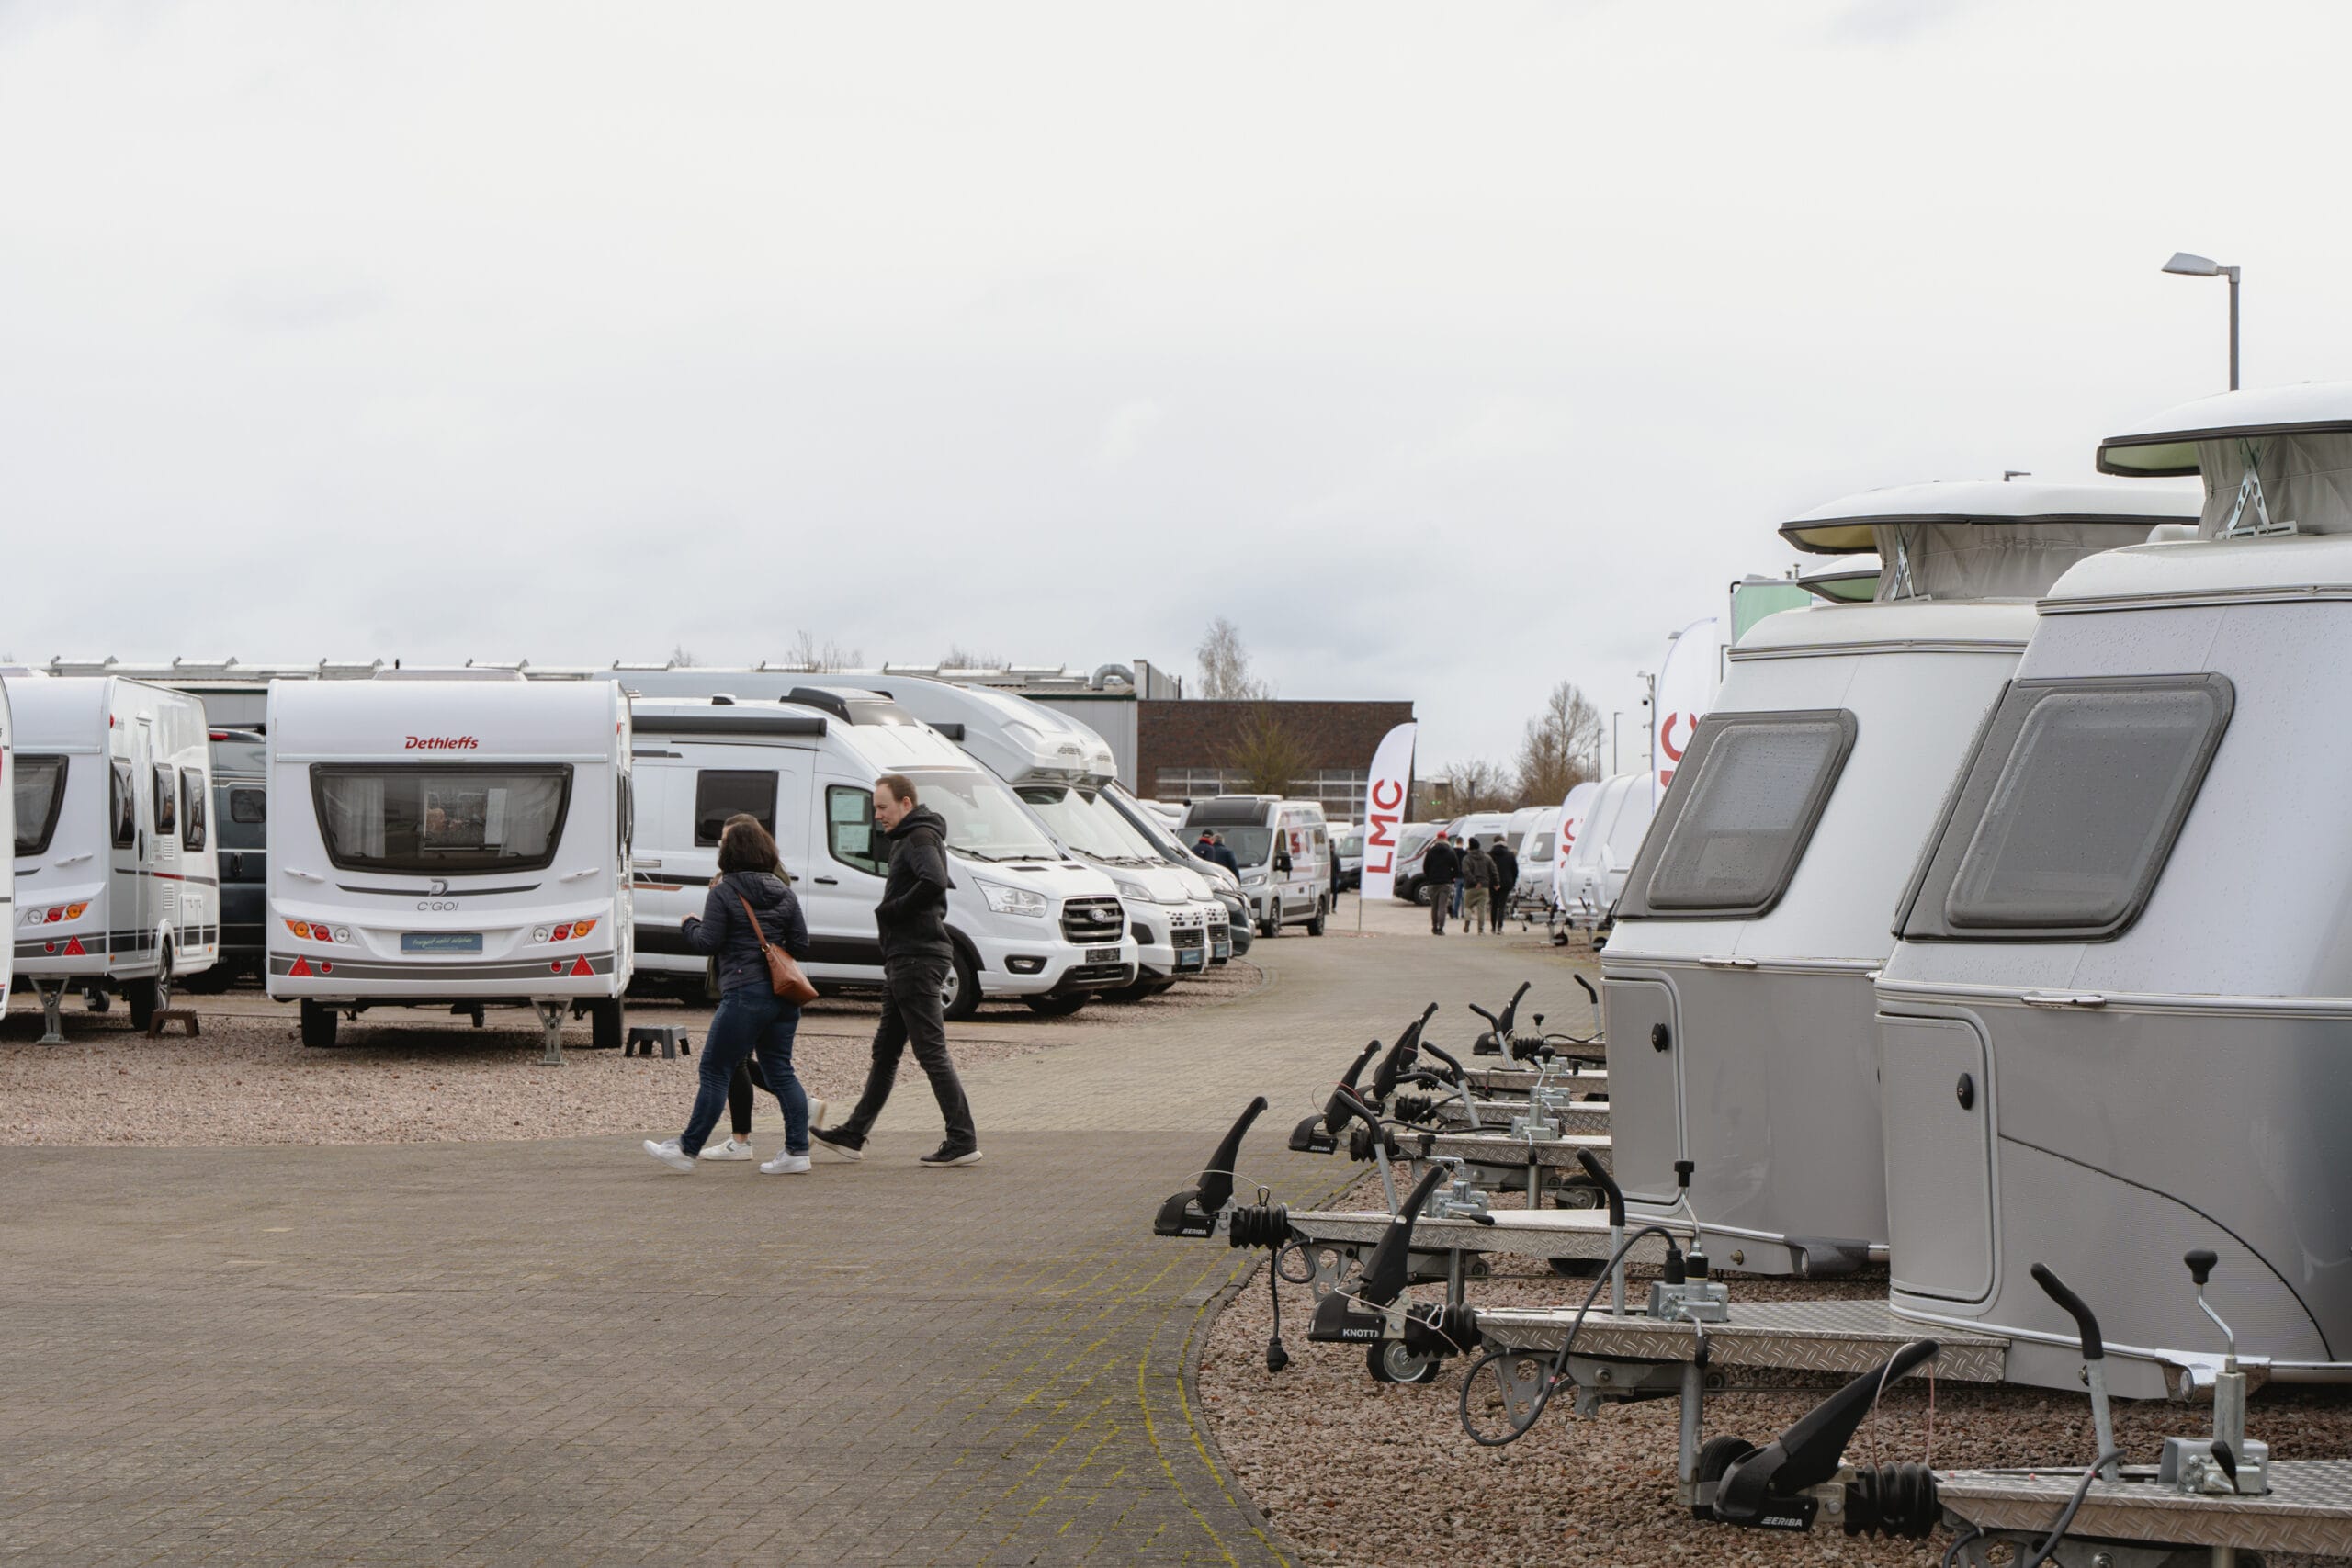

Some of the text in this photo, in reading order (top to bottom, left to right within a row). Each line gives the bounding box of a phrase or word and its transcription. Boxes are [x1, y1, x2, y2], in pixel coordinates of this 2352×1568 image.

[405, 736, 479, 750] Dethleffs
[1366, 779, 1403, 874] LMC
[417, 901, 459, 911] C'GO!
[1342, 1328, 1375, 1337] KNOTT
[1770, 1517, 1803, 1527] ERIBA
